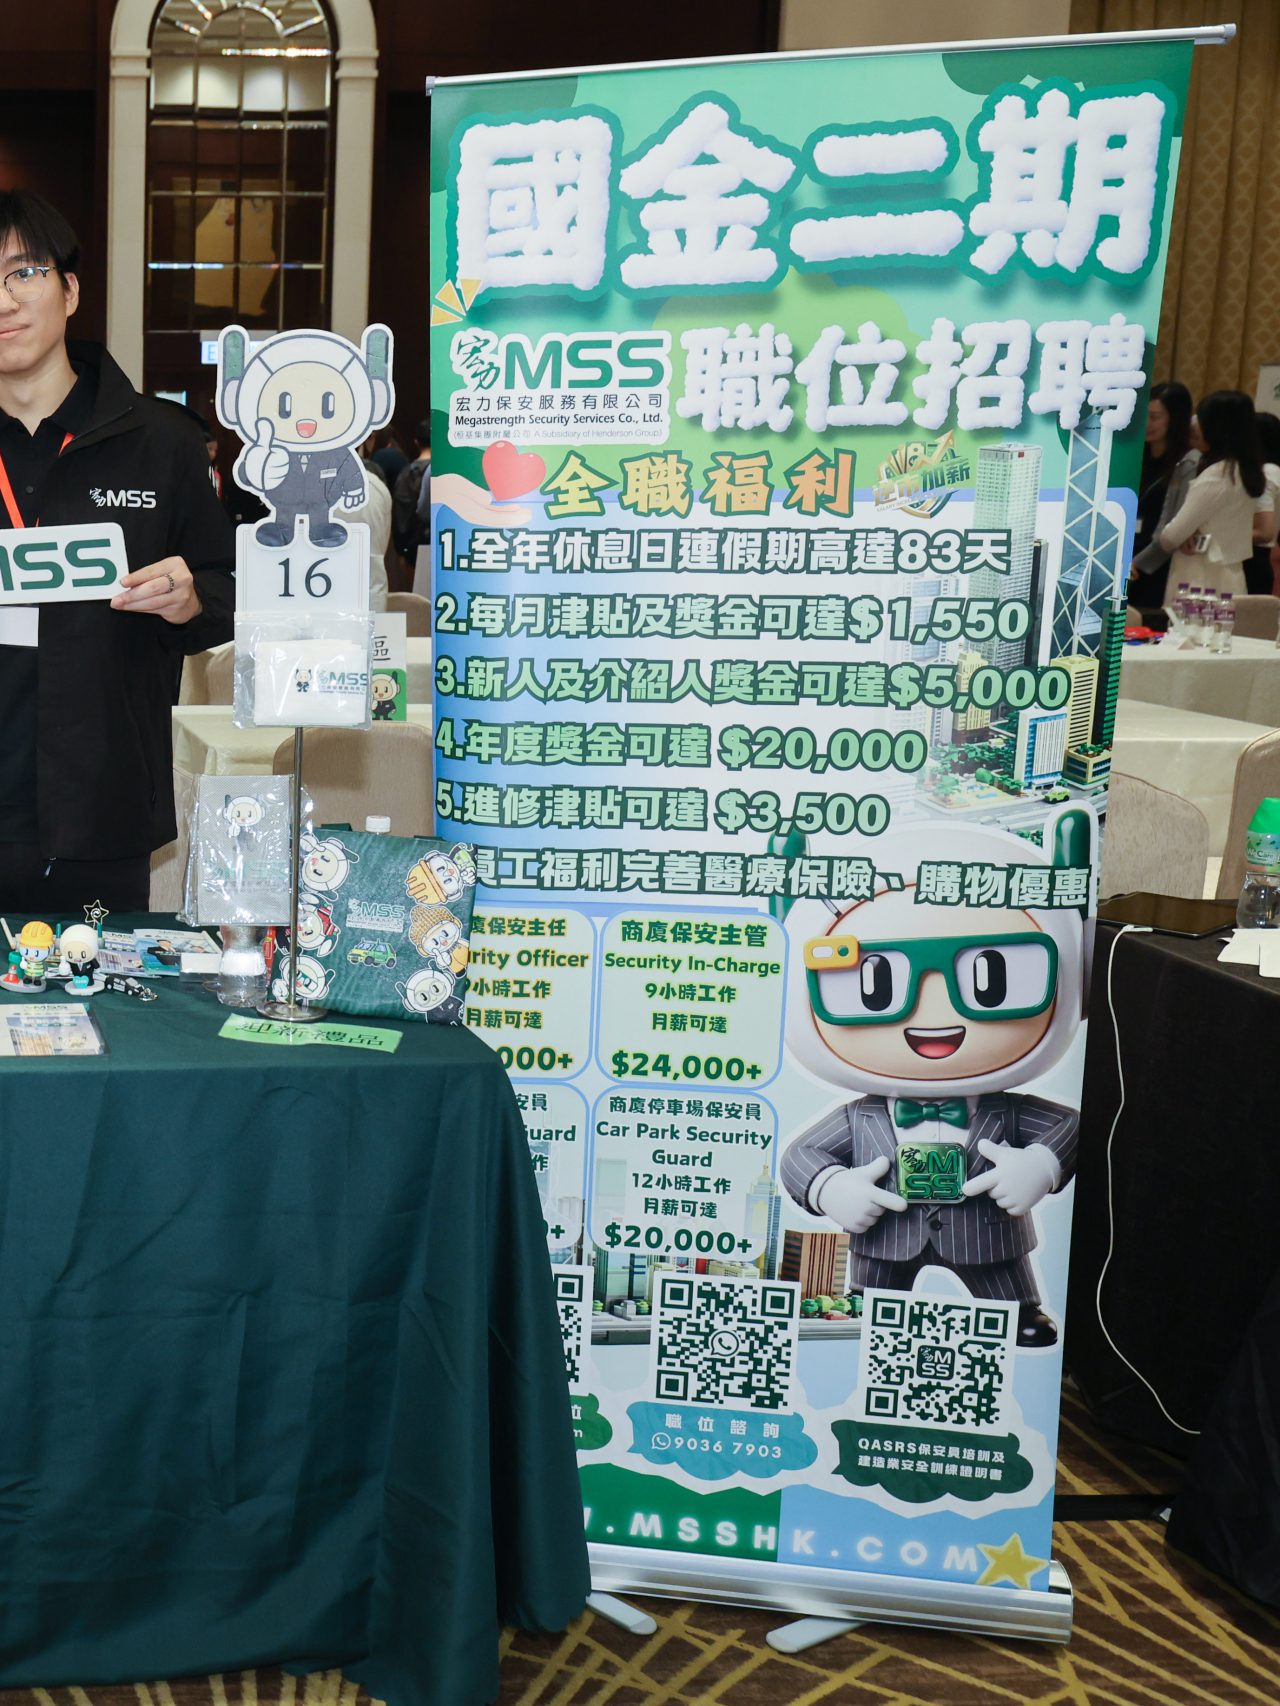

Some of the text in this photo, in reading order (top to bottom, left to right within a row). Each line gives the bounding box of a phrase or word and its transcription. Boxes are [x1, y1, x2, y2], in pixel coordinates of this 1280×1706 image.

[456, 89, 1166, 291] 國金二期
[504, 338, 665, 390] MSS
[676, 312, 1147, 432] 職位招聘
[456, 393, 663, 412] 宏力保安服務有限公司
[455, 412, 663, 428] Megastrength Security Services Co., Ltd.
[541, 430, 581, 440] Subsidiary
[582, 430, 591, 438] of
[591, 429, 633, 438] Henderson
[634, 428, 663, 438] Group)
[541, 449, 857, 519] 全職福利
[106, 489, 157, 509] MSS
[439, 529, 1009, 572] 1.全年休息日連假期高達83天
[278, 557, 333, 599] 16
[436, 659, 1069, 710] 3.新人及介紹人獎金可達$5,000
[436, 718, 924, 773] 4.年度獎金可達 $20,000
[436, 782, 888, 835] 5.進修津貼可達 $3,500
[361, 902, 406, 919] MSS
[621, 920, 768, 947] 商廈保安主管
[516, 949, 589, 967] Officer
[605, 953, 781, 977] Security In-Charge
[645, 982, 737, 1003] 9小時工作
[466, 1008, 542, 1029] 月薪可達
[652, 1012, 727, 1033] 月薪可達
[612, 1050, 762, 1081] $24,000+
[609, 1096, 762, 1121] 商廈停車場保安員
[596, 1121, 773, 1150] Car Park Security
[652, 1149, 713, 1167] Guard
[632, 1173, 732, 1195] 12小時工作
[644, 1197, 717, 1219] 月薪可達
[604, 1222, 753, 1254] $20,000+
[665, 1413, 780, 1438] 職位諮詢
[674, 1437, 782, 1459] 9036 7903
[858, 1437, 1005, 1463] QASRS保安員培訓及
[858, 1455, 1003, 1481] 建造業安全訓練證明書
